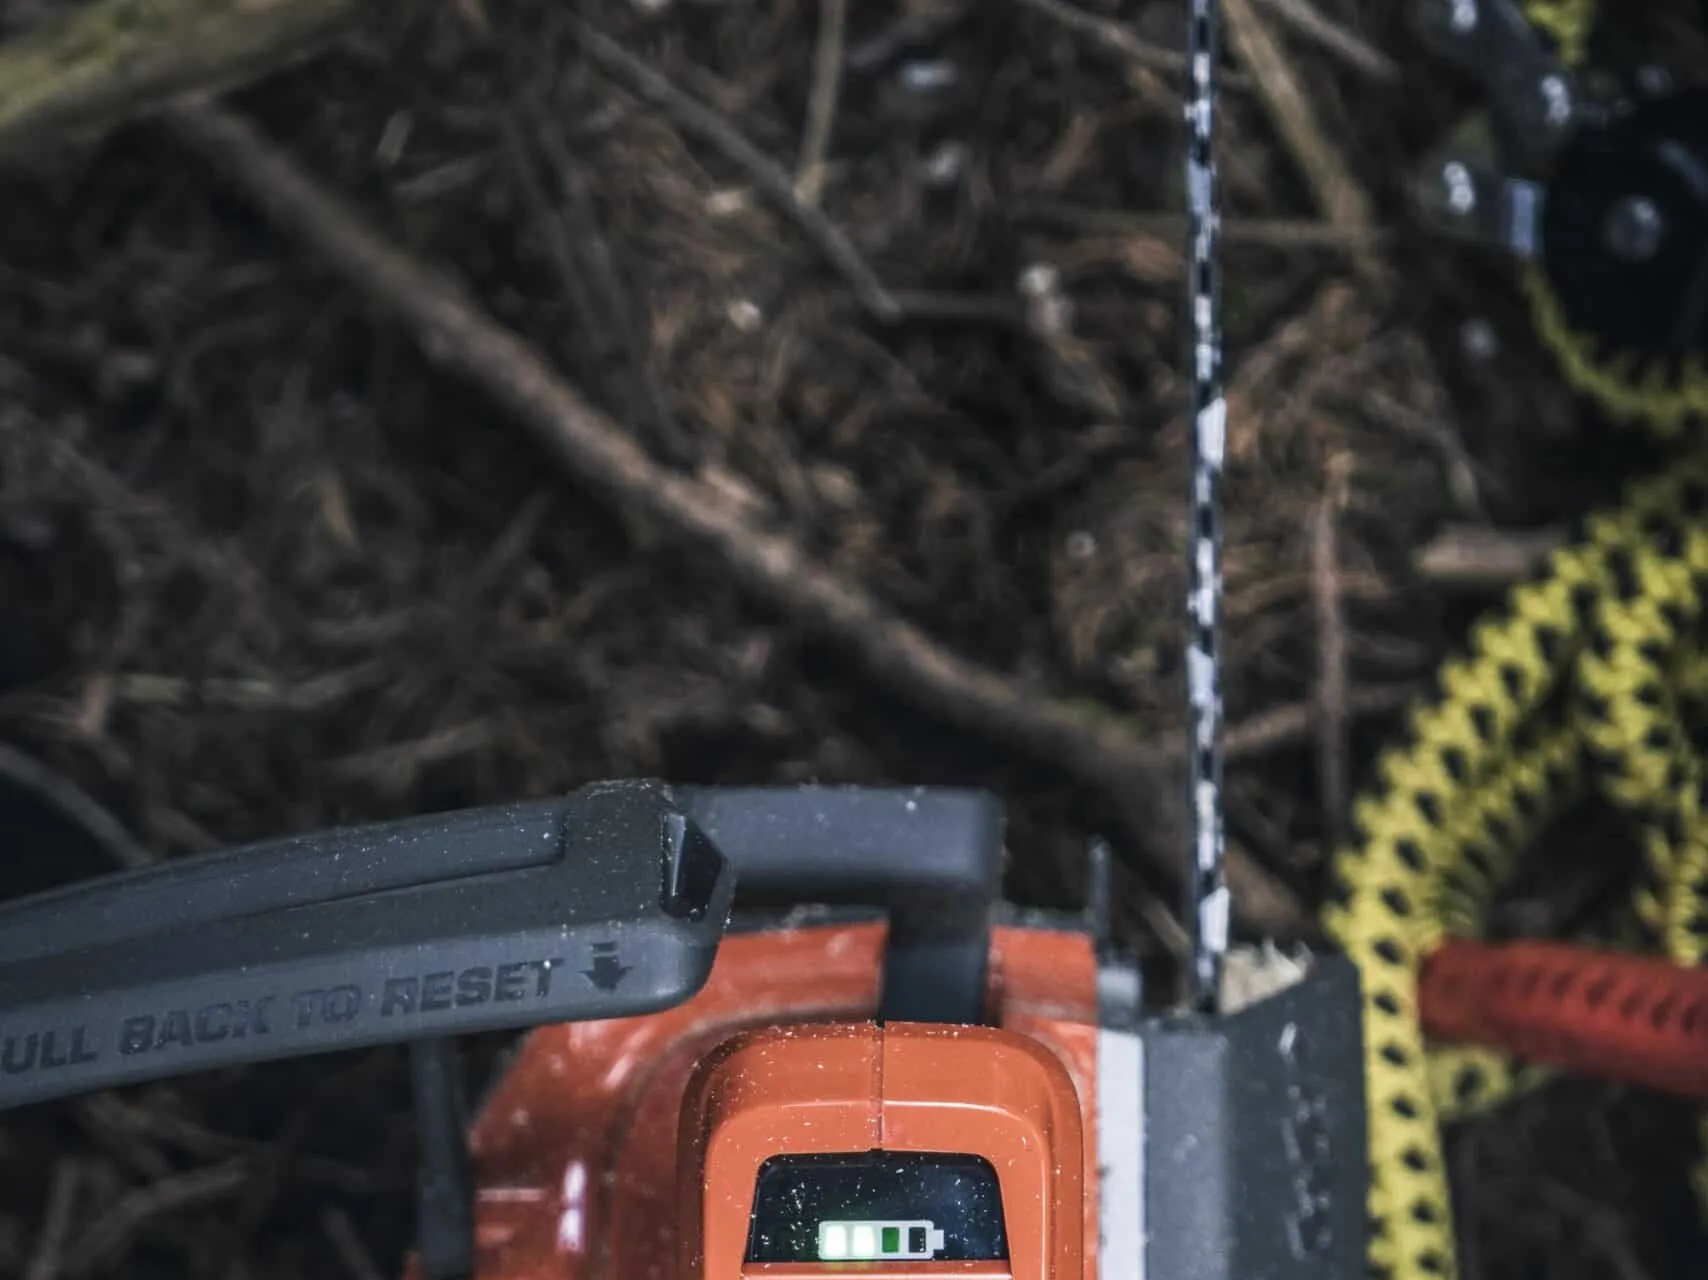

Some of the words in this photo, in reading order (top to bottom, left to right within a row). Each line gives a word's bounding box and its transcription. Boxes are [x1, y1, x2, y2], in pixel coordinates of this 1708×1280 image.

[0, 1026, 99, 1075] ULL
[119, 995, 272, 1056] BACK
[296, 983, 362, 1028] TO
[380, 957, 564, 1018] RESET
